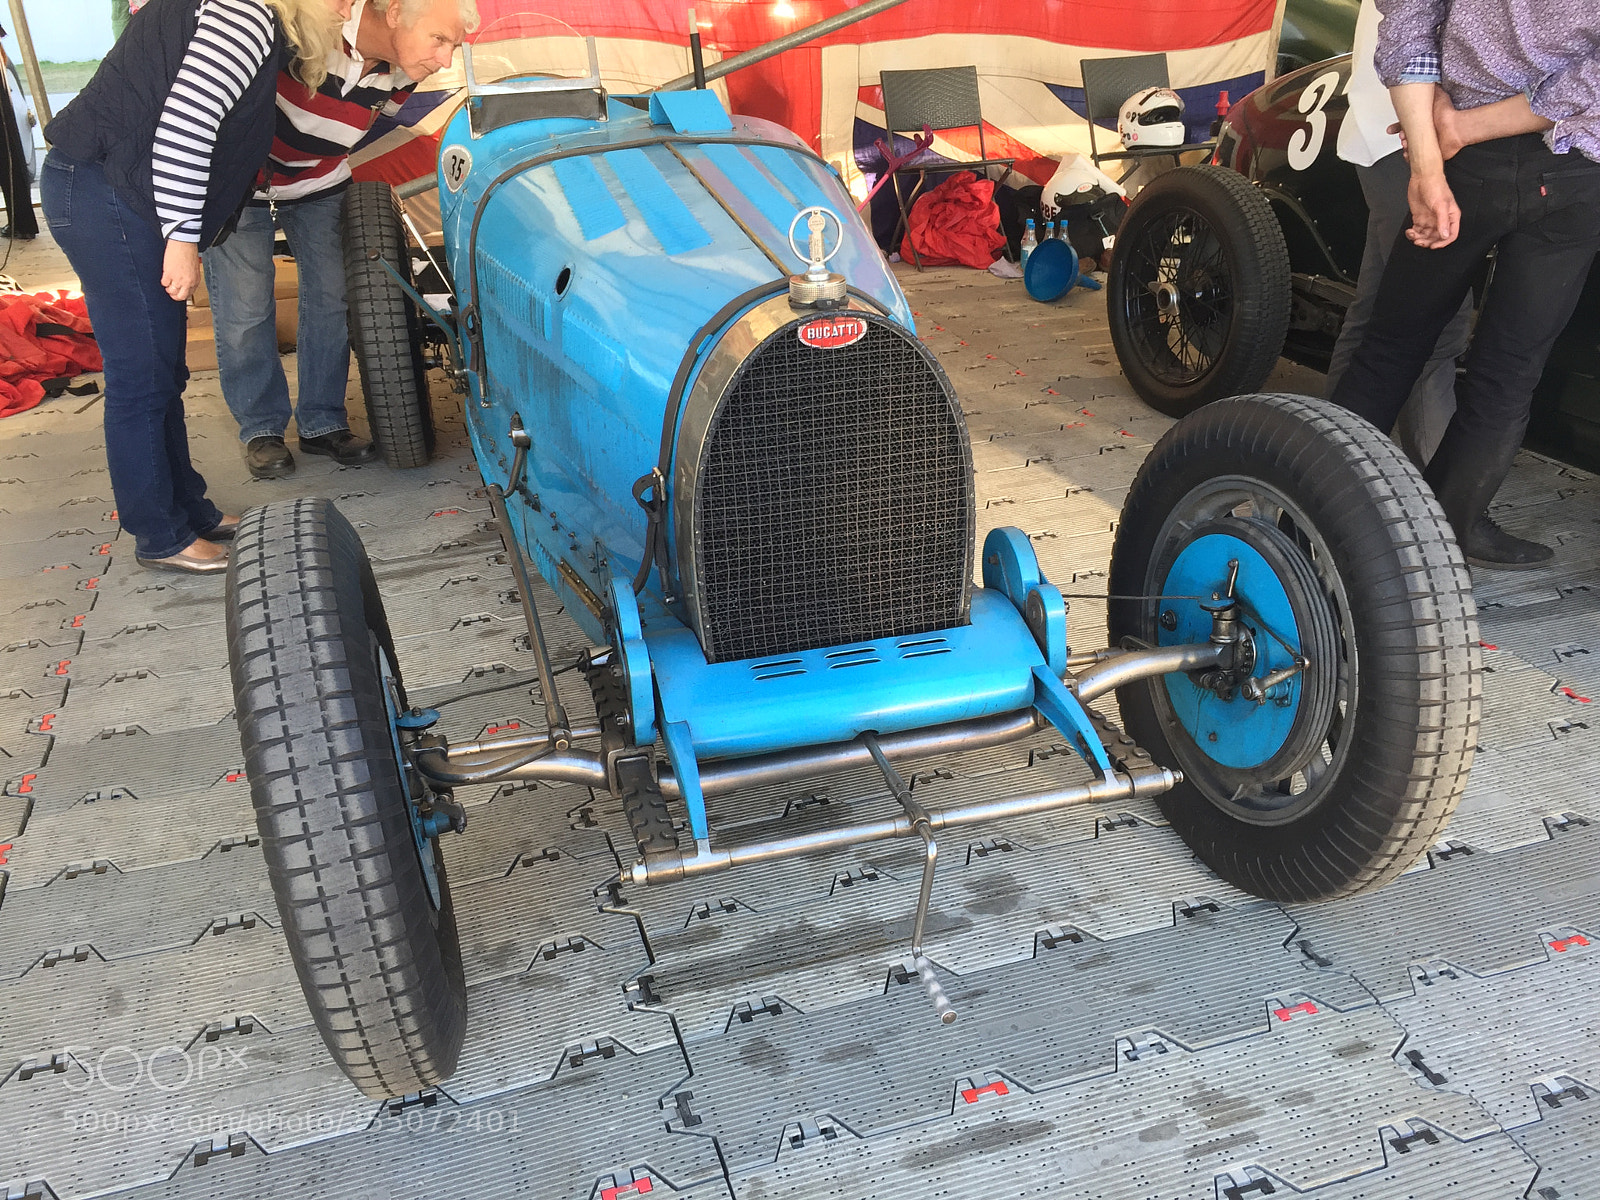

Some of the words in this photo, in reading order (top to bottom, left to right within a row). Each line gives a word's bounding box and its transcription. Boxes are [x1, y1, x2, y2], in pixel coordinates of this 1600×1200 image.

[1287, 71, 1352, 171] 3
[449, 154, 465, 182] 35
[807, 322, 858, 339] BUGATTI
